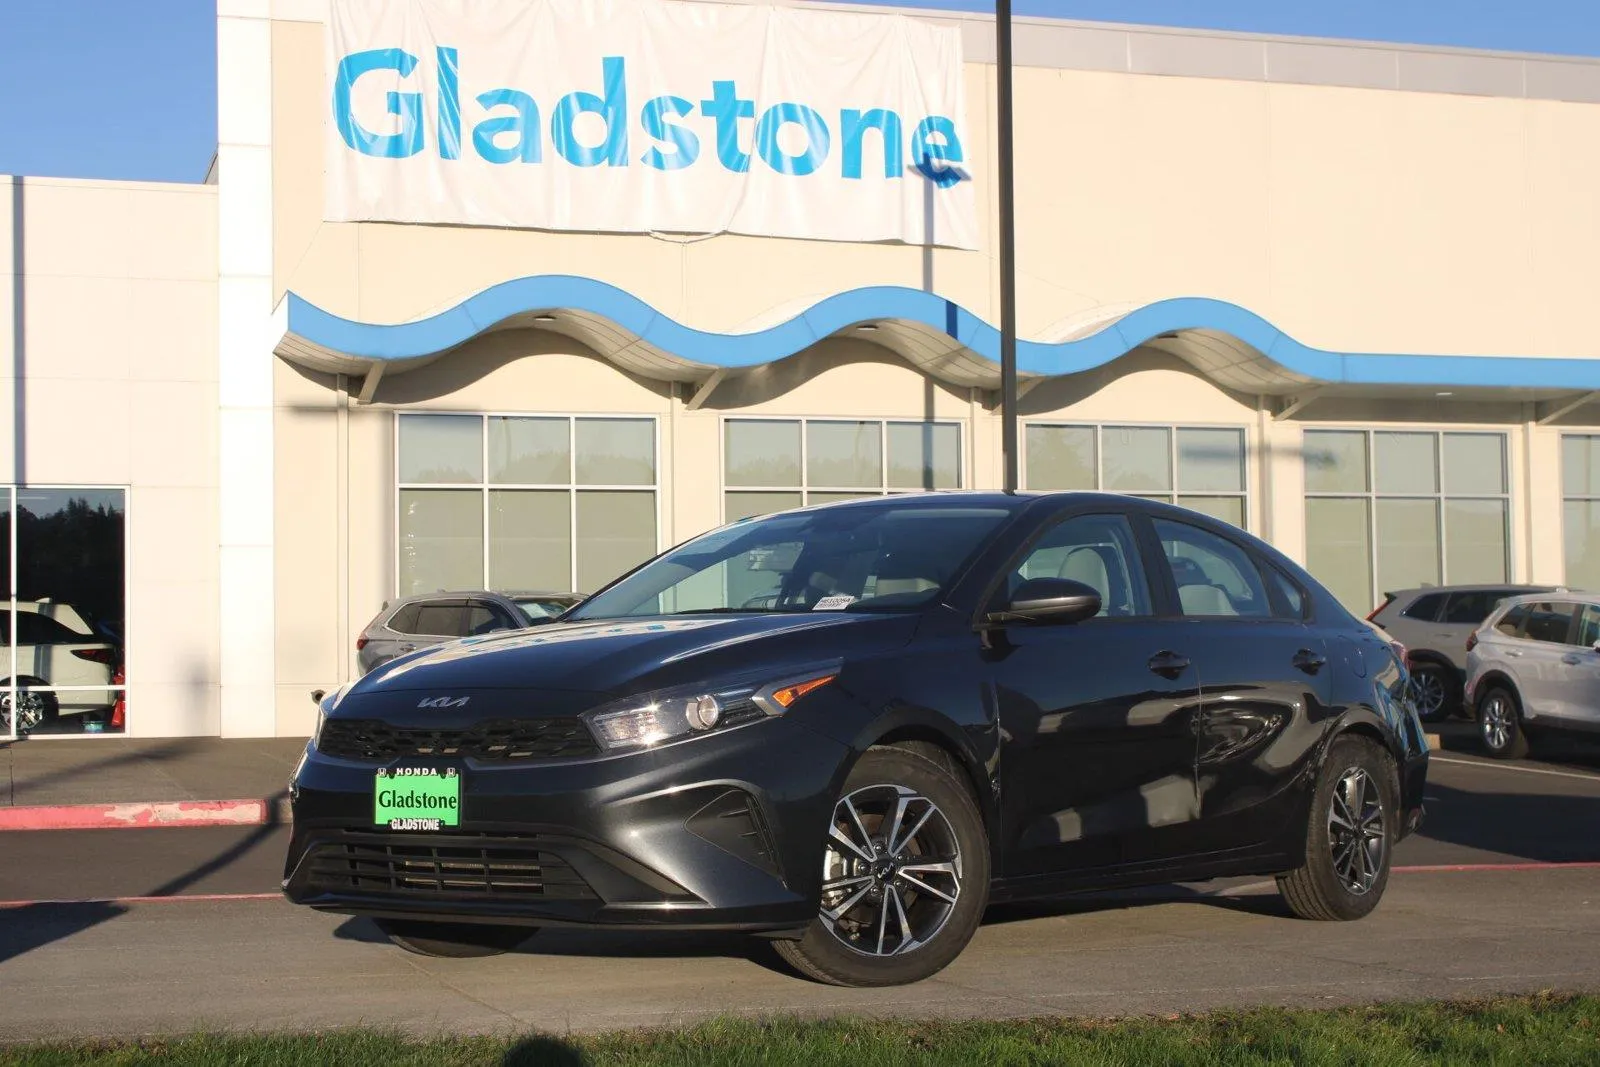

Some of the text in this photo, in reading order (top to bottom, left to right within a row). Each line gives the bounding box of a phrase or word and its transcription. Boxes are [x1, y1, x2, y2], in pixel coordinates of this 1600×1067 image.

[332, 46, 964, 189] Gladstone
[417, 696, 470, 708] KIA
[396, 767, 437, 776] HONDA
[379, 790, 457, 809] Gladstone
[391, 818, 440, 830] GLADSTONE
